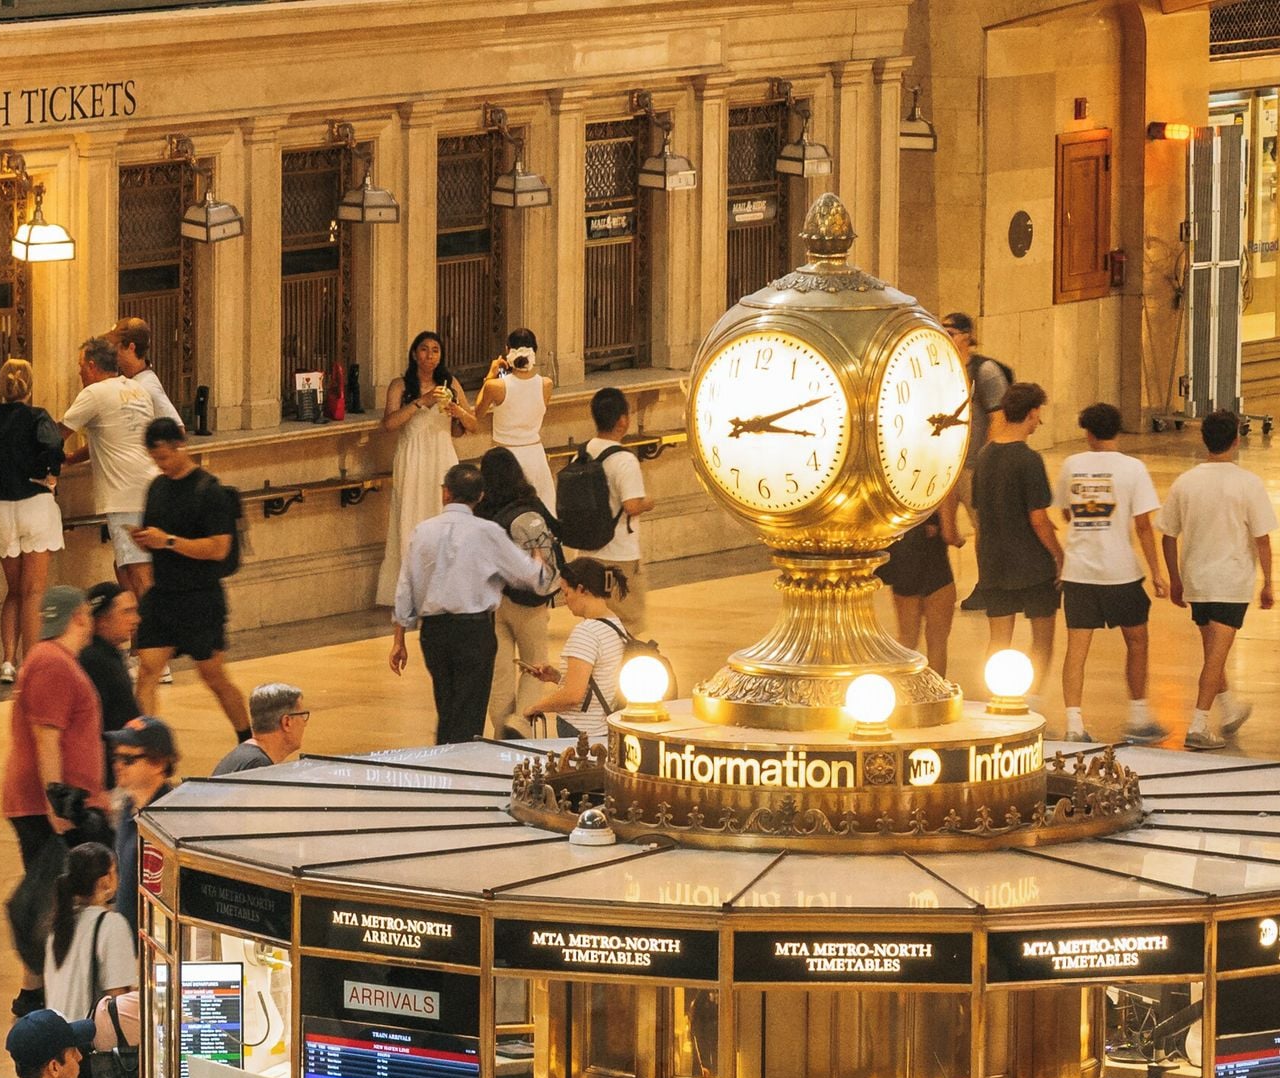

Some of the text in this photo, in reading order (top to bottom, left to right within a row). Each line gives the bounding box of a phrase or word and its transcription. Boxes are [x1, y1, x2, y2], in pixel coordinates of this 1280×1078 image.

[20, 79, 138, 125] TICKETS
[754, 347, 774, 372] 12
[926, 343, 940, 367] 12
[729, 357, 741, 380] 11
[791, 357, 798, 381] 1
[910, 356, 923, 379] 11
[896, 380, 911, 405] 10
[894, 413, 904, 440] 9
[711, 446, 722, 469] 8
[806, 450, 822, 472] 4
[896, 447, 908, 472] 8
[730, 467, 741, 489] 7
[758, 477, 772, 500] 6
[785, 473, 800, 494] 5
[910, 468, 922, 492] 7
[926, 473, 937, 498] 6
[658, 740, 856, 789] Information
[332, 910, 453, 937] MTA METRO-NORTH
[362, 929, 422, 949] ARRIVALS
[532, 931, 682, 953] MTA METRO-NORTH
[775, 942, 933, 958] MTA METRO-NORTH
[1022, 934, 1169, 957] MTA METRO-NORTH
[561, 948, 652, 966] TIMETABLES
[805, 957, 902, 972] TIMETABLES
[1051, 952, 1140, 970] TIMETABLES
[348, 985, 435, 1015] ARRIVALS
